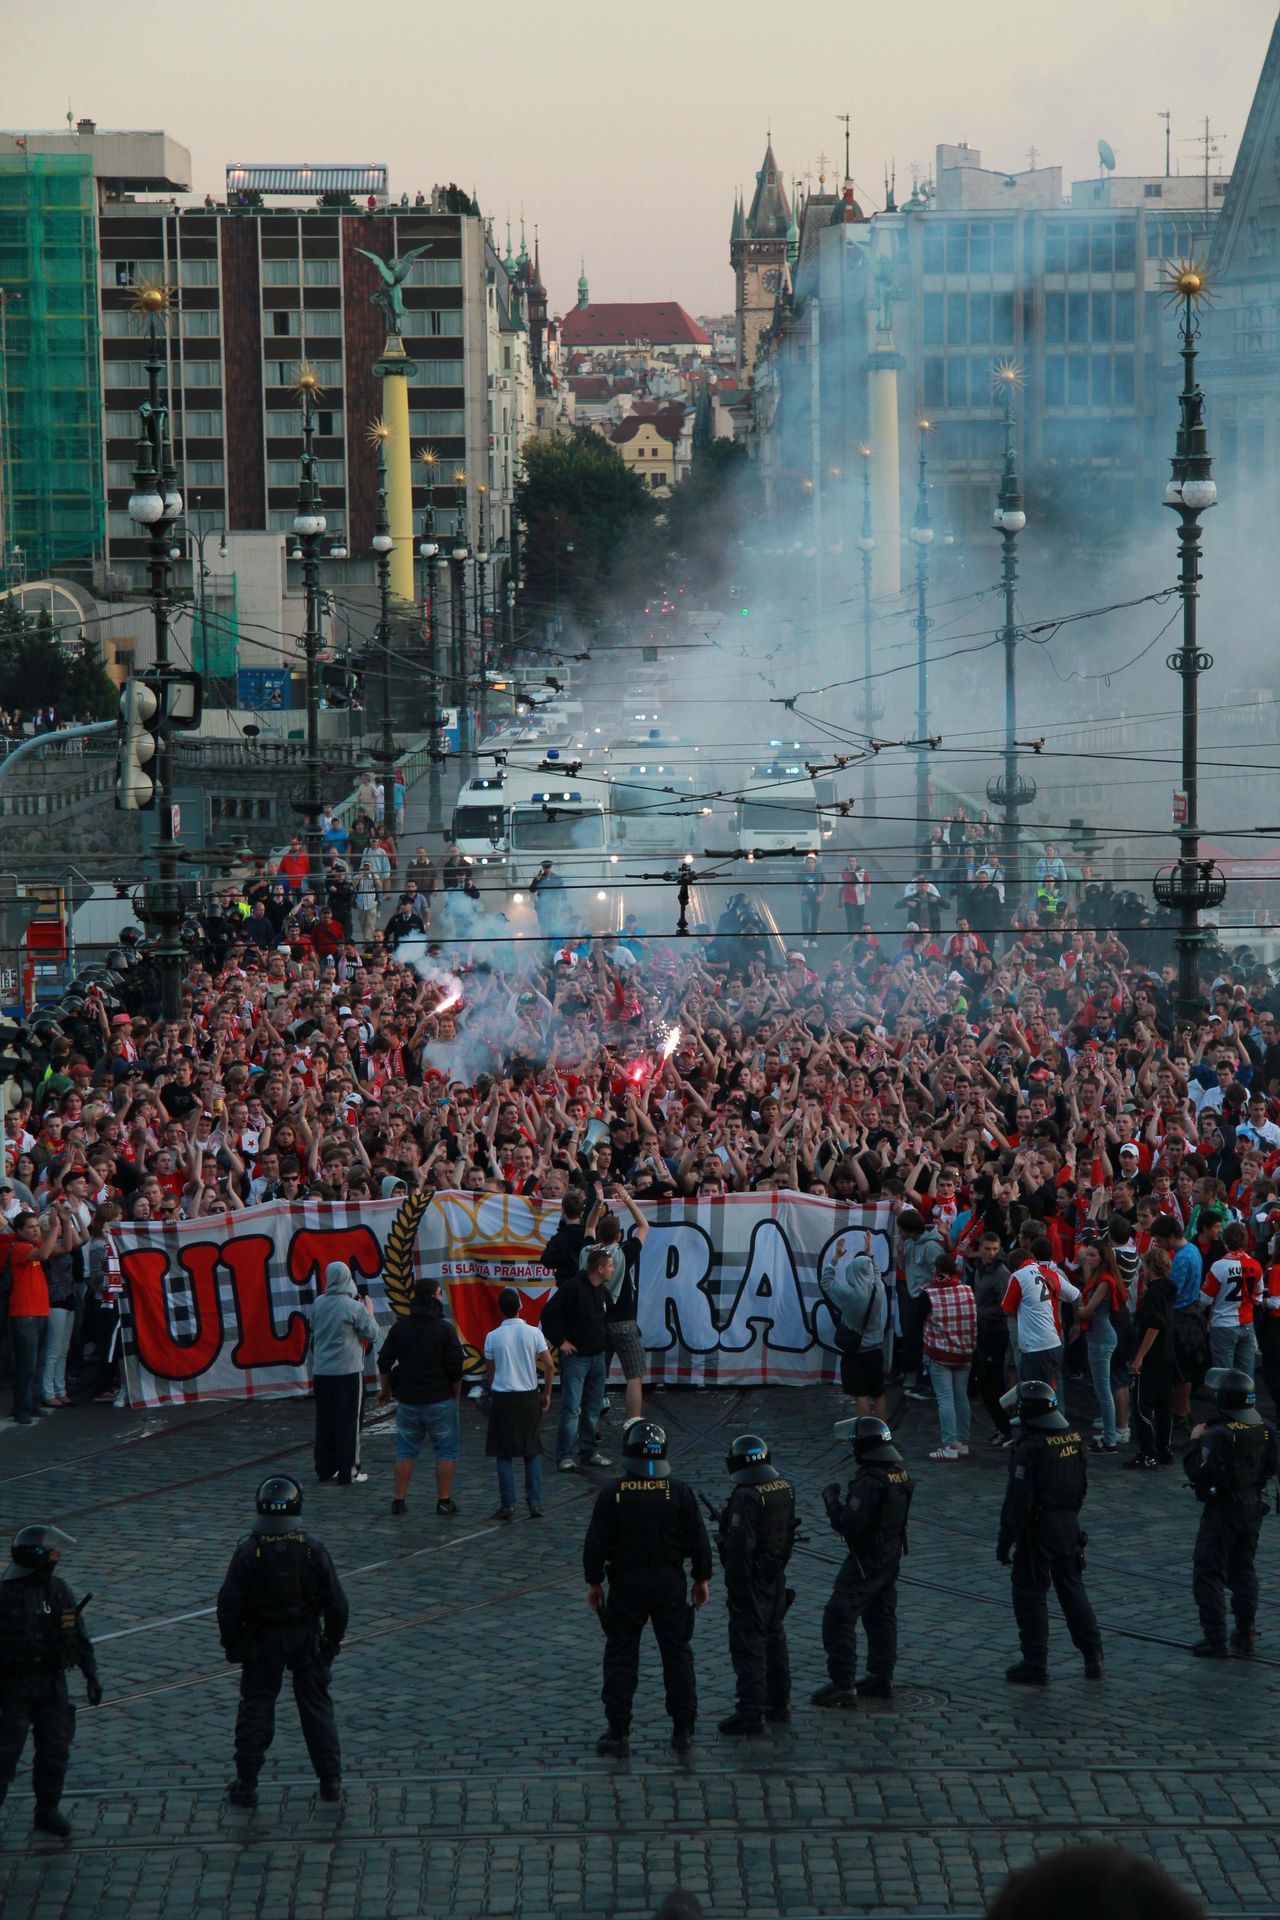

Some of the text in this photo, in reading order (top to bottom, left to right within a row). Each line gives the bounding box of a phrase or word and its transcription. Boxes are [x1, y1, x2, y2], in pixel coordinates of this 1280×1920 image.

[493, 1265, 532, 1277] PRAHA
[119, 1223, 385, 1382] ULT
[620, 1480, 667, 1491] POLICIE
